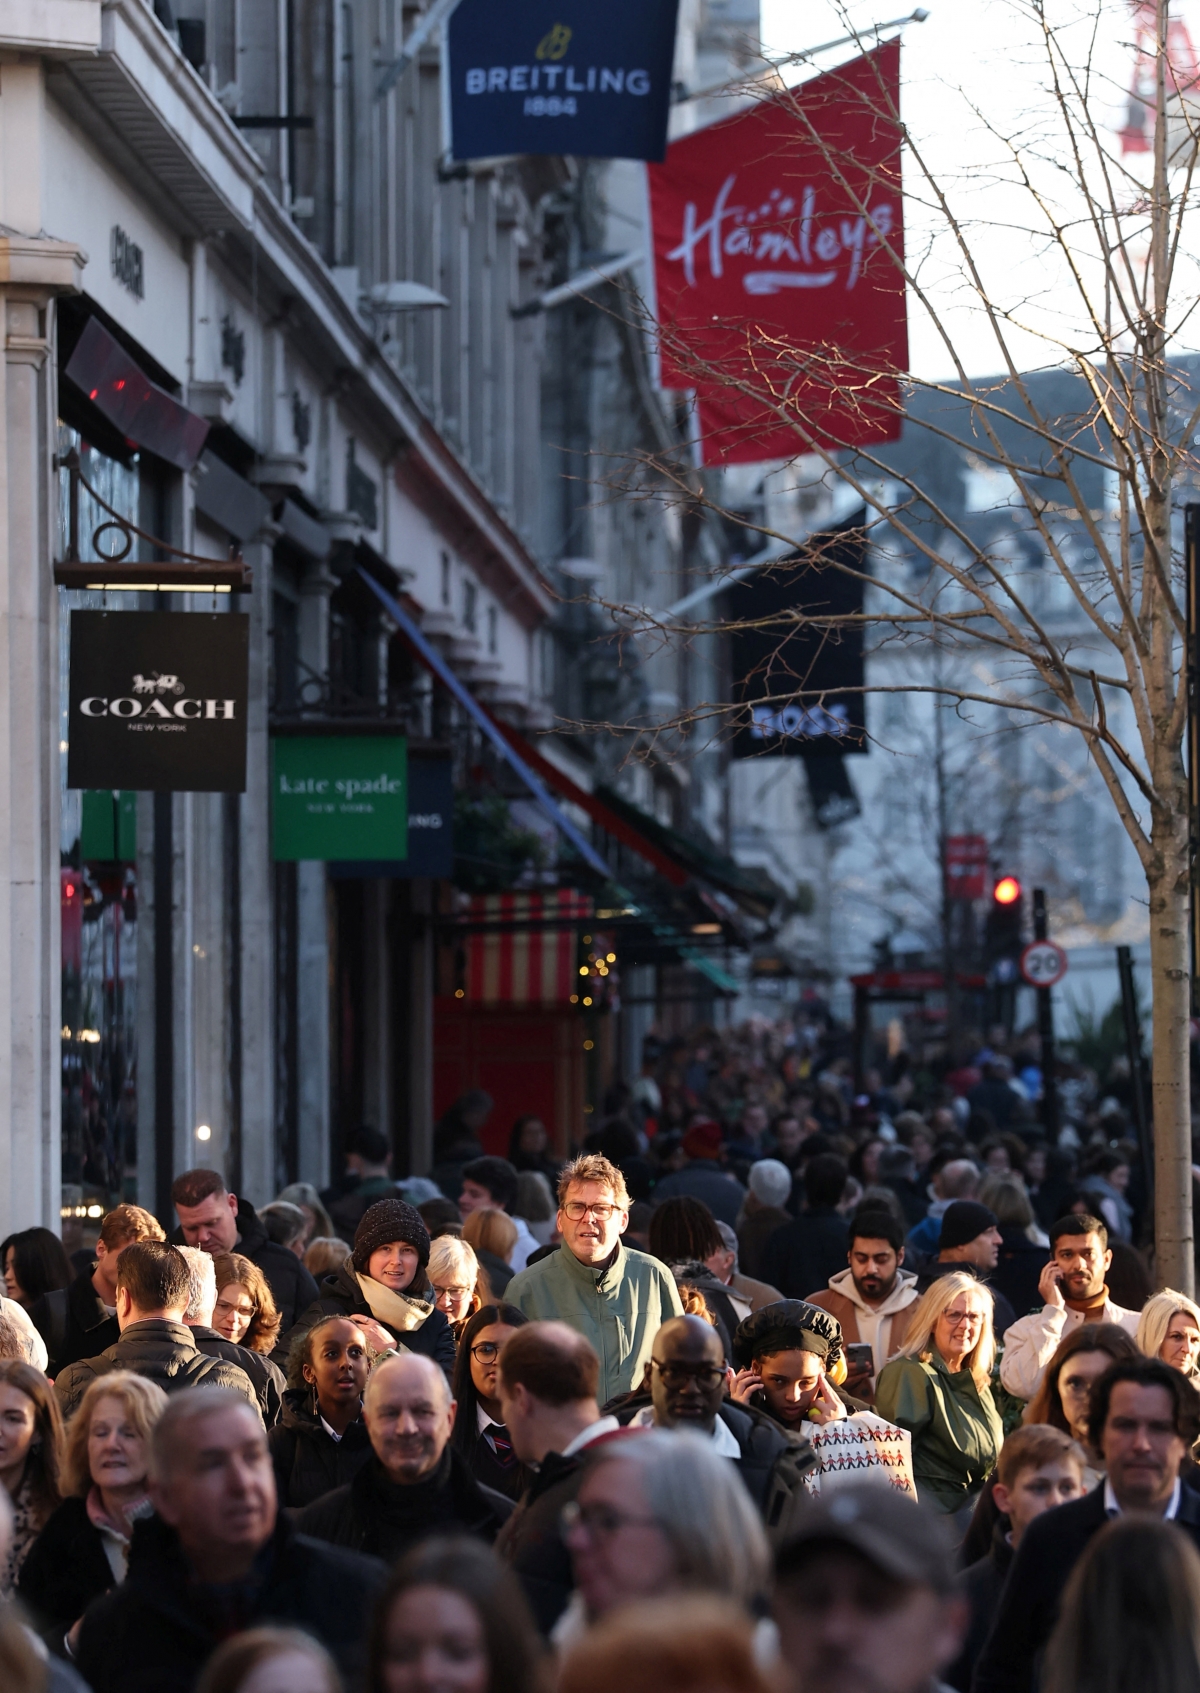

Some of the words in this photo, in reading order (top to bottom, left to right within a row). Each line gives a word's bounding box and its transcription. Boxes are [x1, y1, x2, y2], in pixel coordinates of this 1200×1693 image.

[466, 65, 649, 96] BREITLING
[523, 95, 577, 117] 1884
[665, 173, 893, 290] Hamleys
[80, 696, 236, 719] COACH
[127, 723, 155, 732] NEW
[157, 723, 187, 732] YORK
[750, 704, 849, 738] BOSS
[280, 774, 329, 794] kate
[335, 773, 401, 800] spade
[1029, 952, 1061, 975] 20
